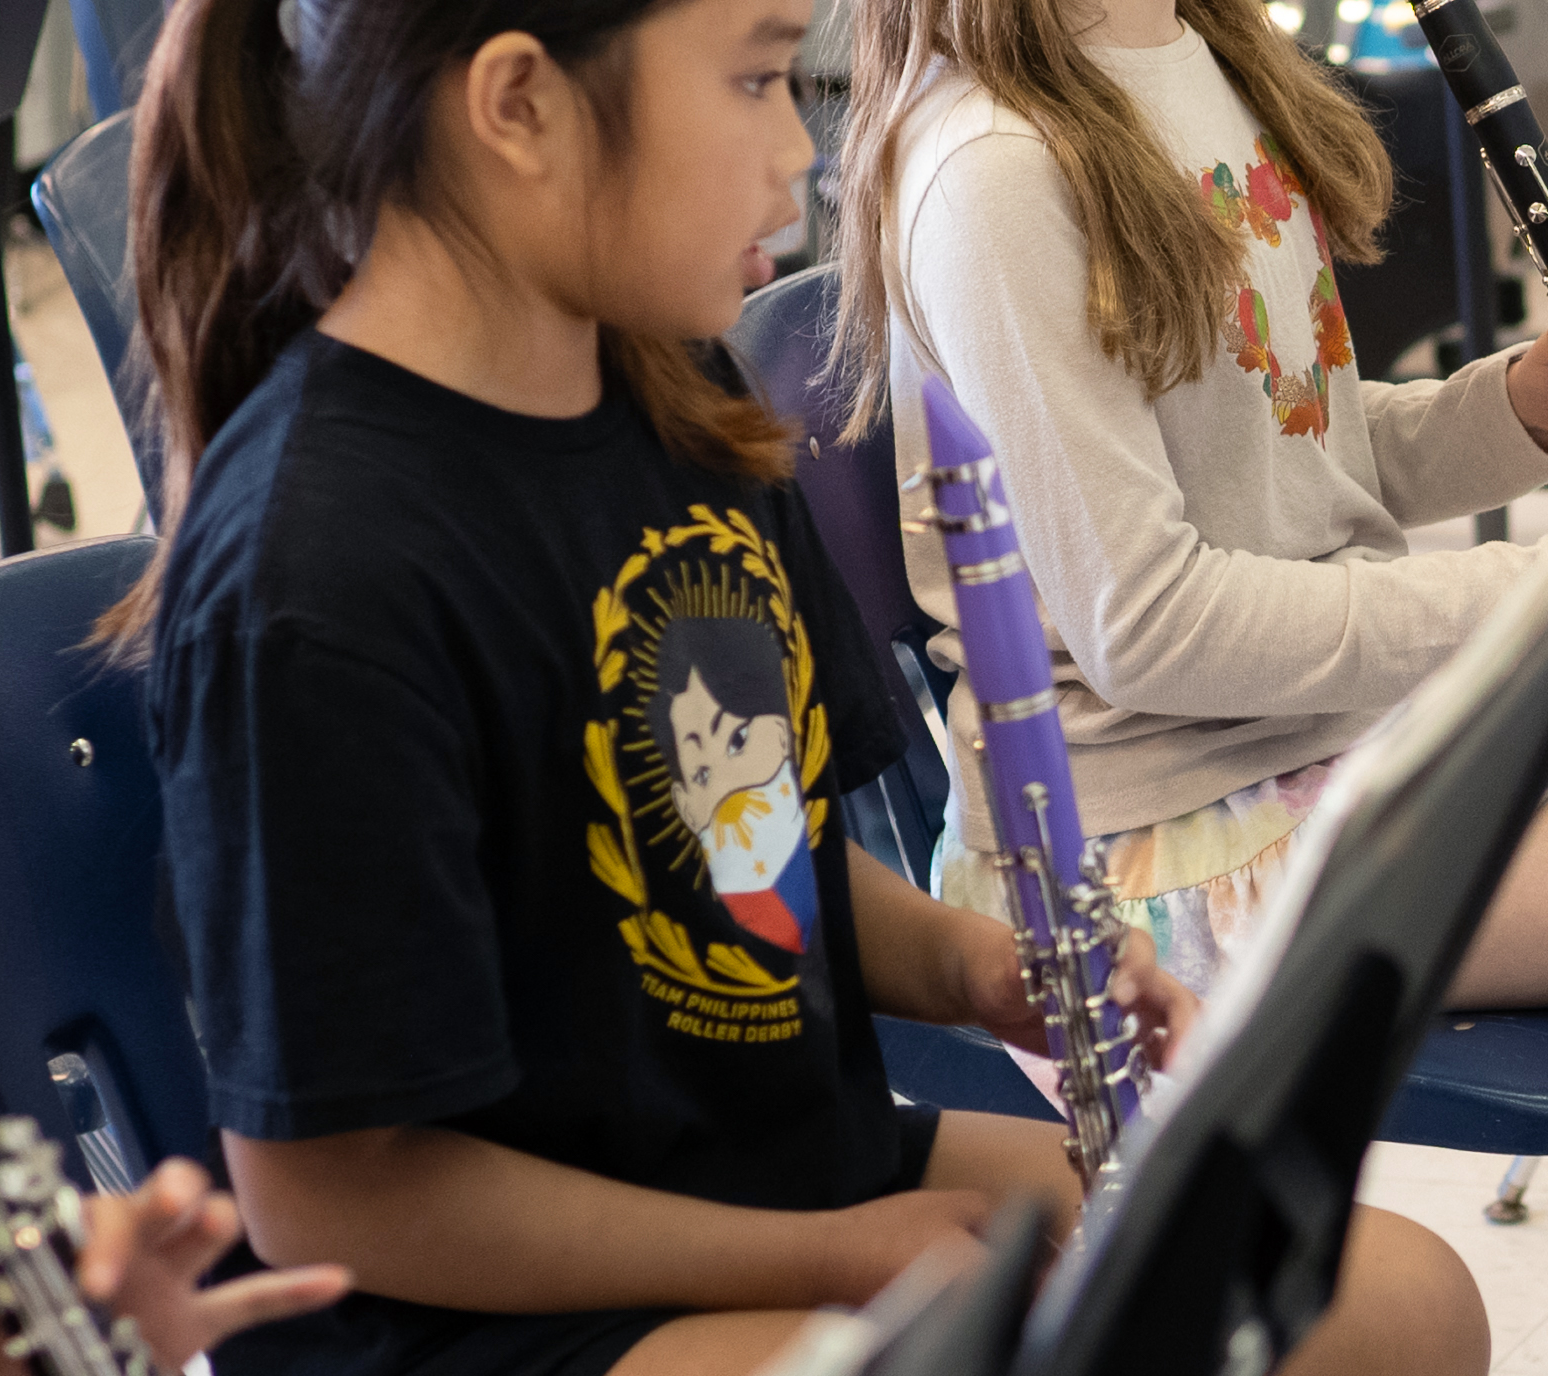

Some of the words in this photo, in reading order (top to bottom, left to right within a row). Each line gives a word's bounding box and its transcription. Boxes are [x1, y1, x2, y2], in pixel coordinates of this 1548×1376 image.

[641, 973, 685, 1005] TEAM
[686, 991, 799, 1020] PHILIPPINES
[667, 1010, 742, 1042] ROLLER
[743, 1018, 802, 1043] DERBY
